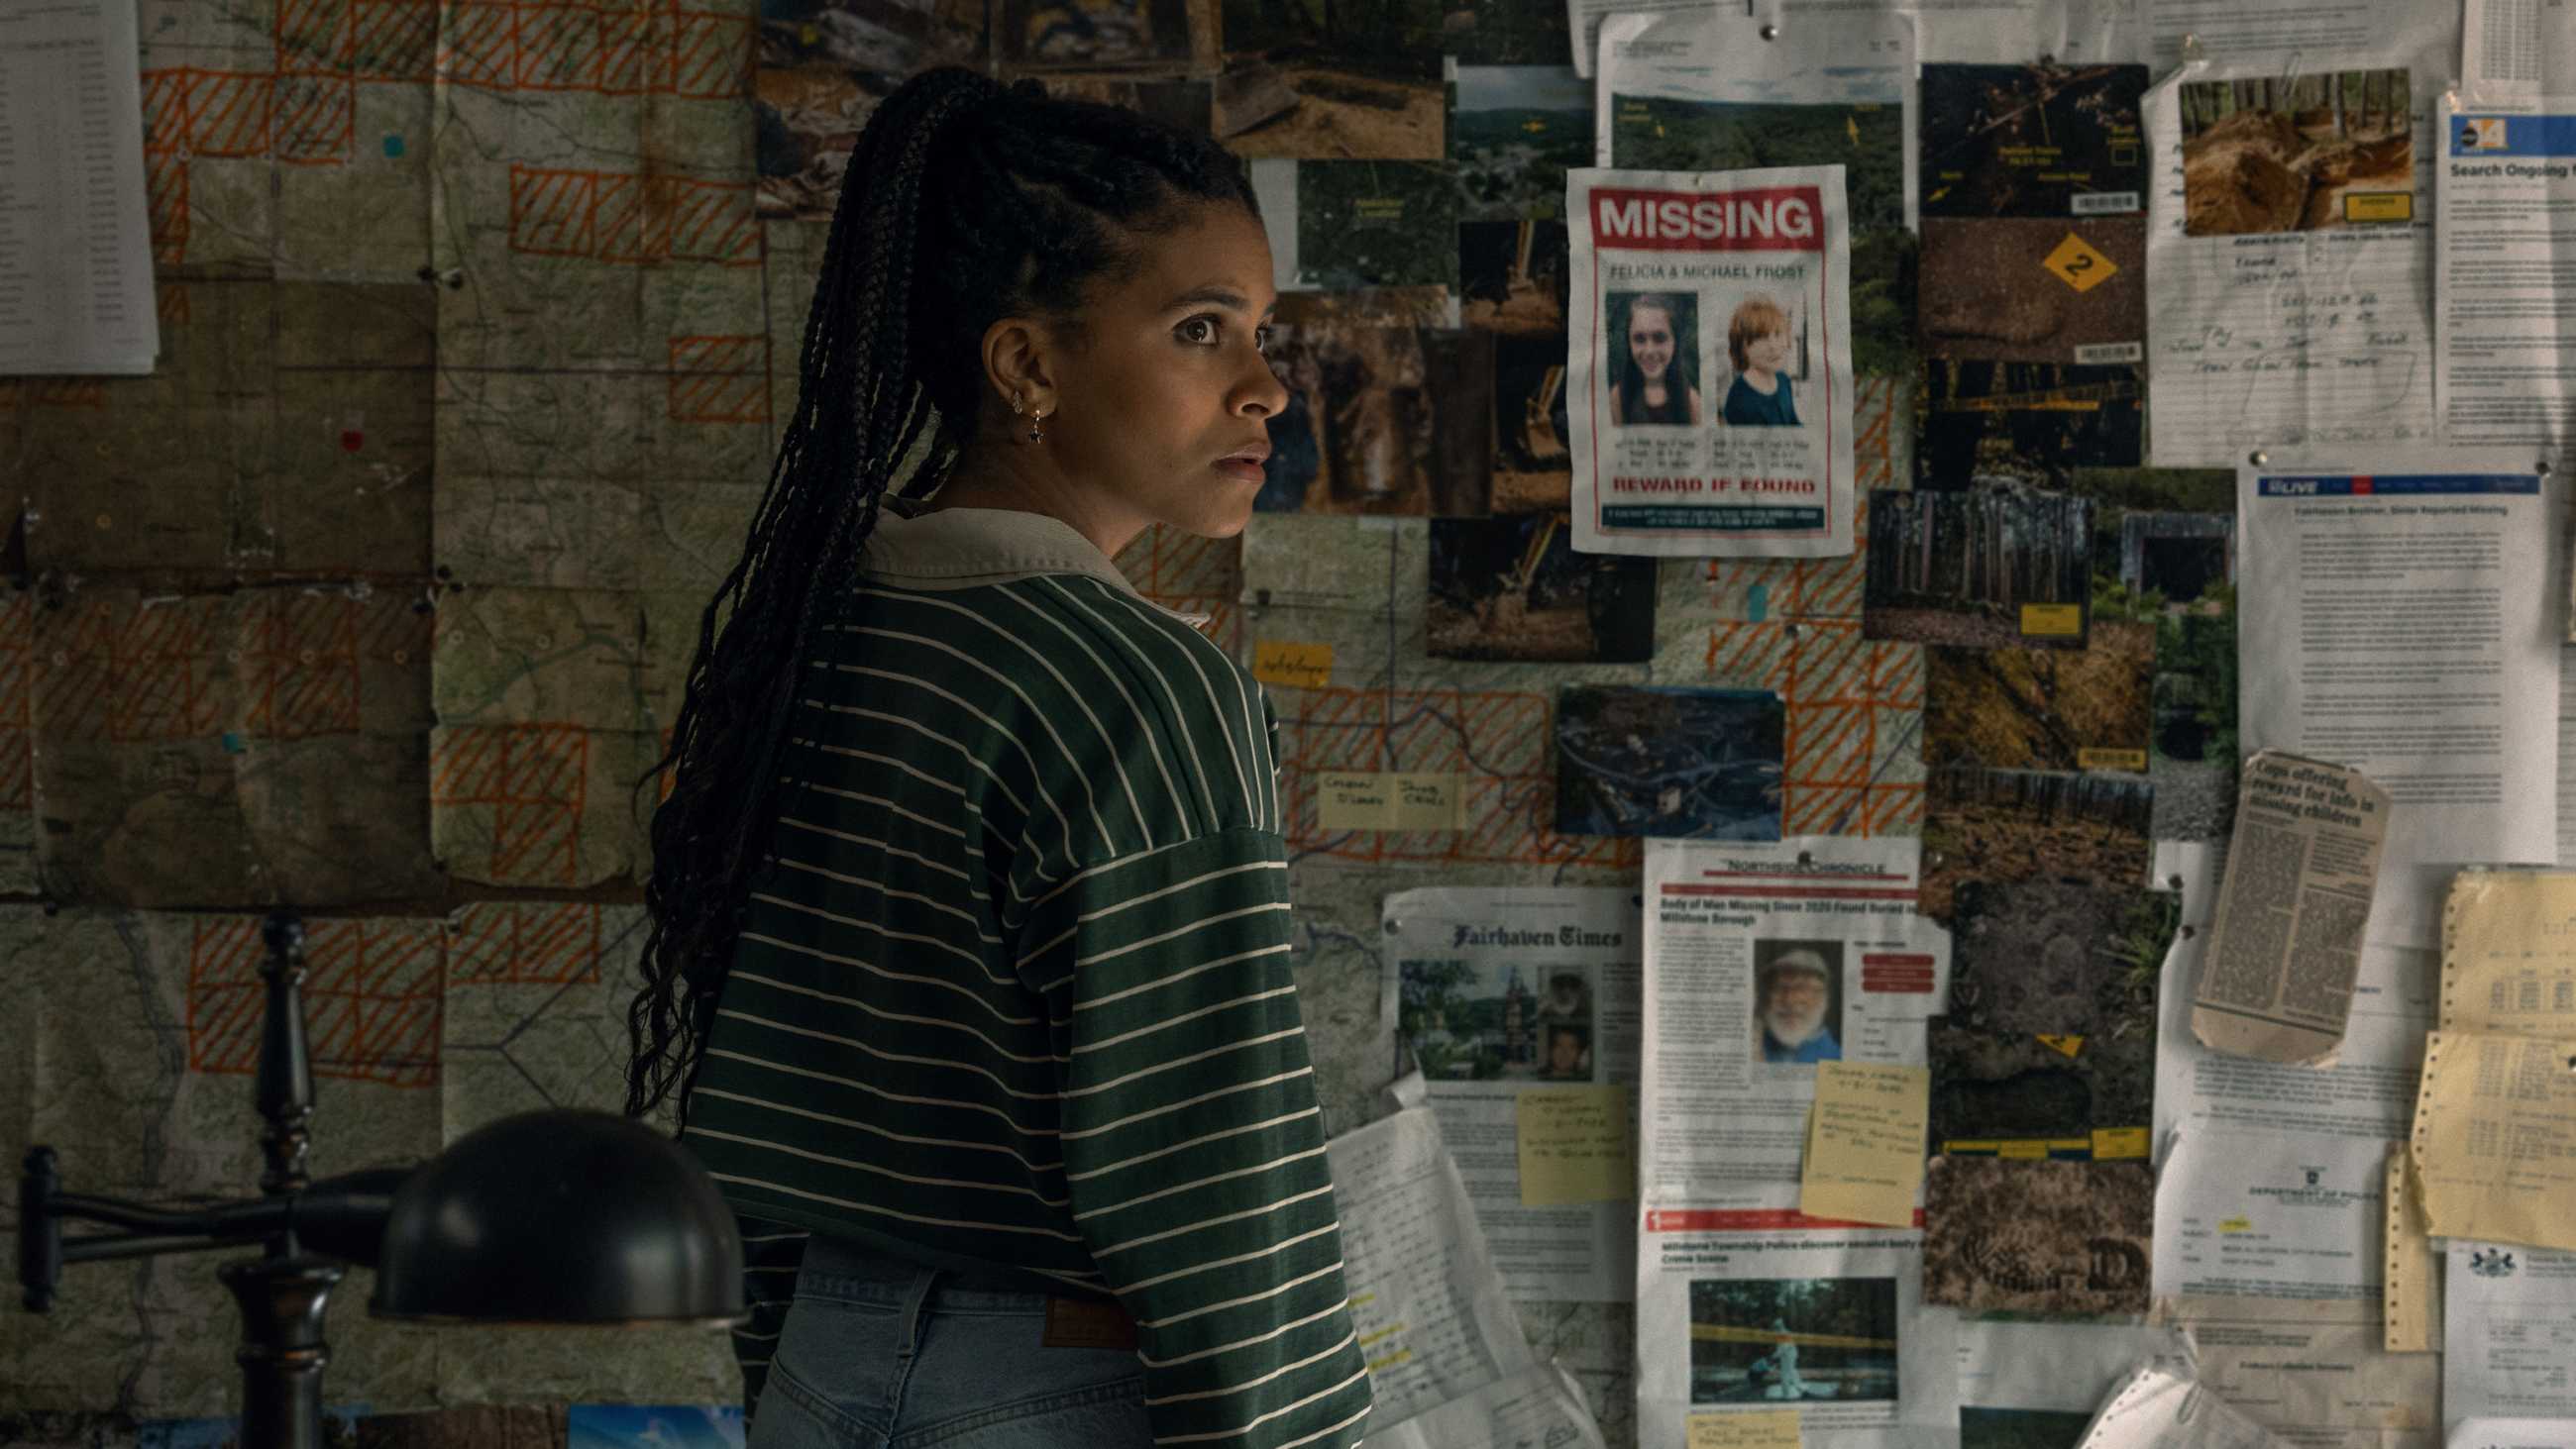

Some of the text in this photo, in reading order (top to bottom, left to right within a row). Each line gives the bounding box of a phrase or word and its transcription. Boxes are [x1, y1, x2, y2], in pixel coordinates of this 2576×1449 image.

[2450, 164, 2567, 179] Search Ongoing
[1600, 199, 1814, 239] MISSING
[1610, 264, 1664, 280] FELICIA
[1683, 263, 1751, 280] MICHAEL
[2064, 255, 2093, 277] 2
[1613, 476, 1815, 494] REWARD IF FOUND
[2305, 803, 2362, 827] children
[1452, 924, 1622, 948] Fairhaven Times
